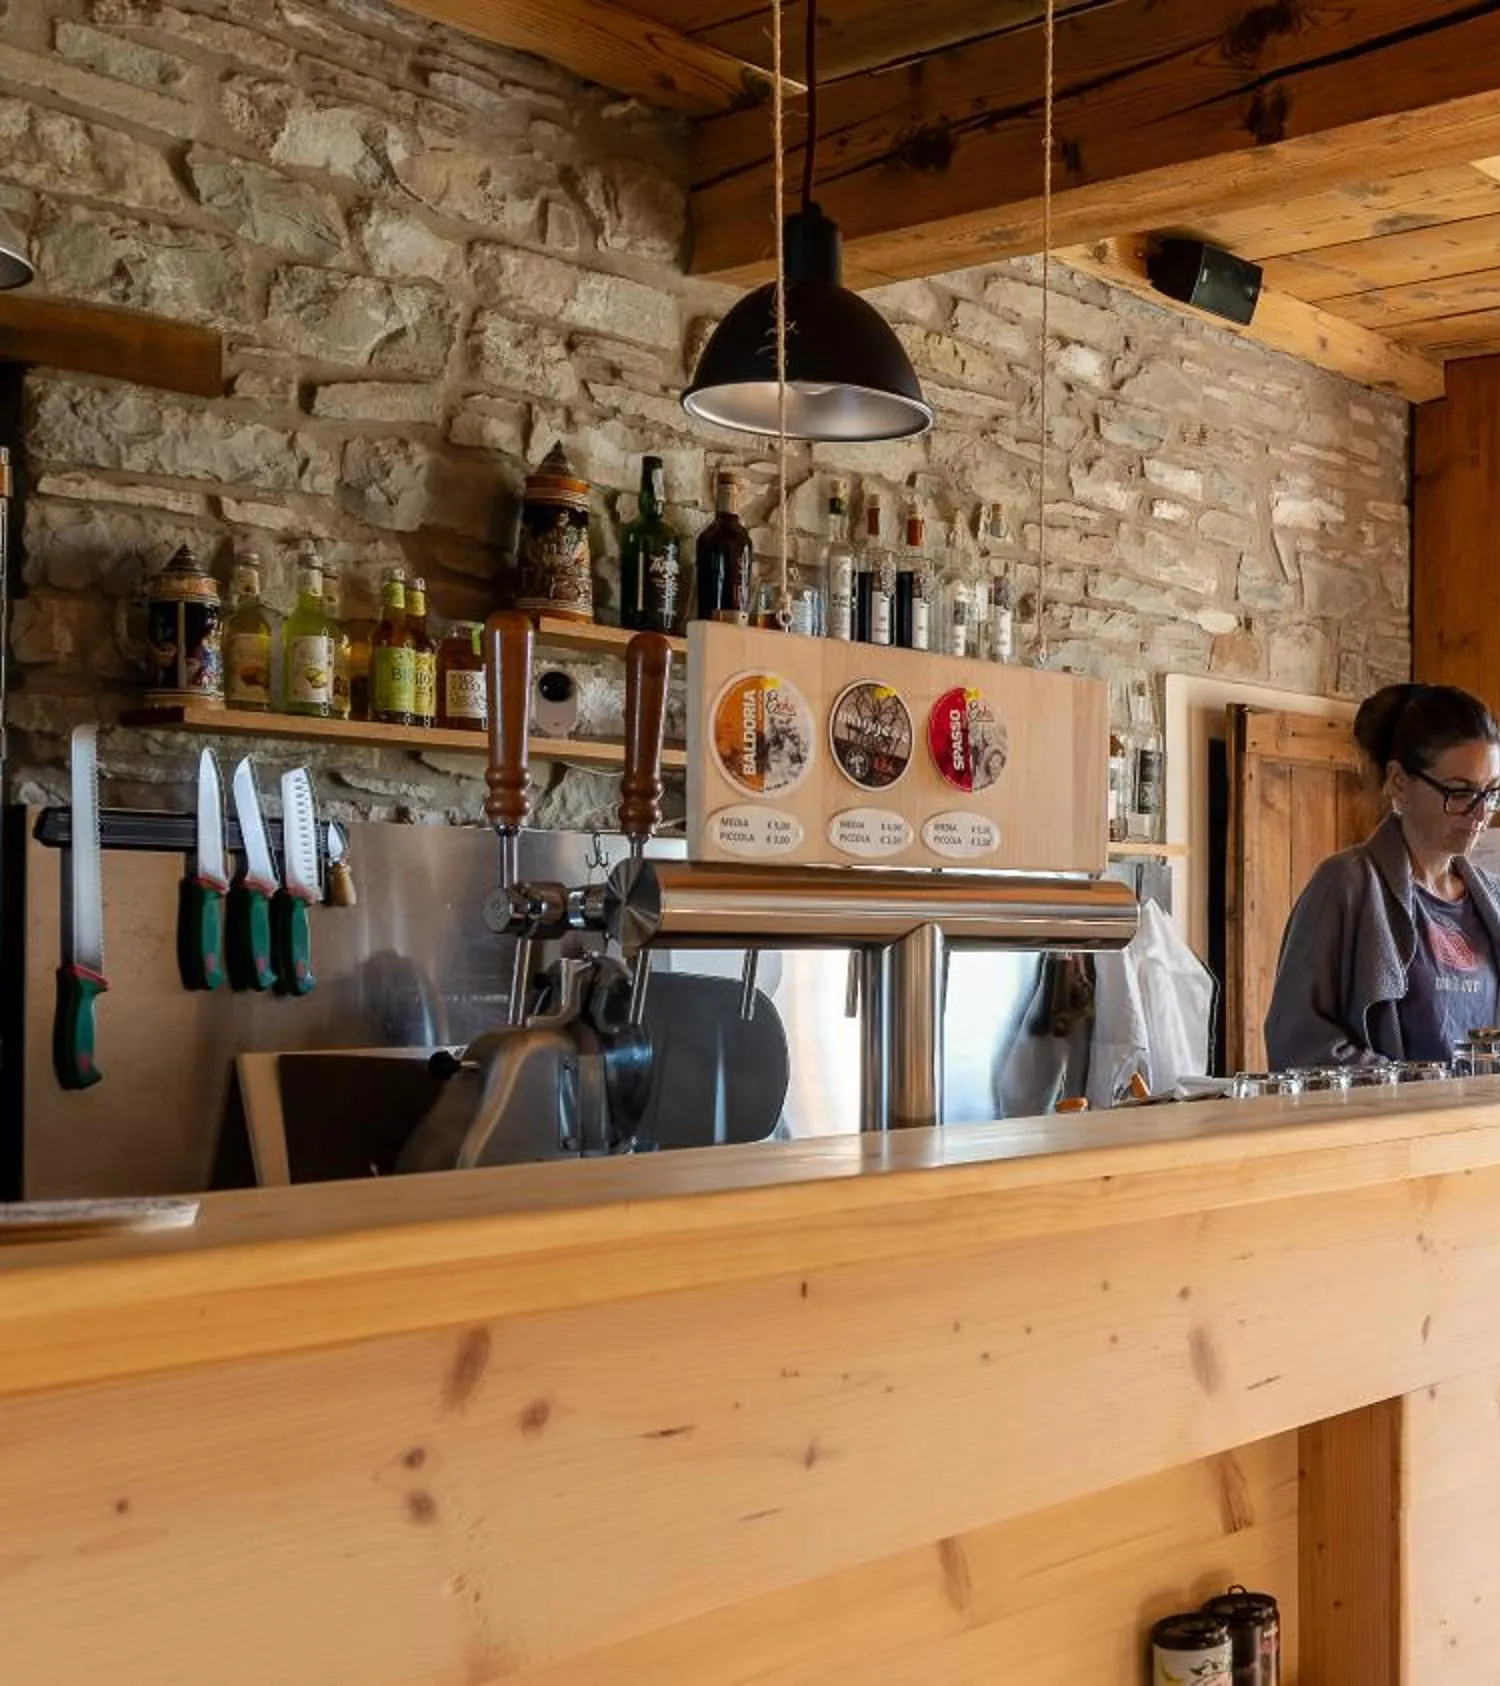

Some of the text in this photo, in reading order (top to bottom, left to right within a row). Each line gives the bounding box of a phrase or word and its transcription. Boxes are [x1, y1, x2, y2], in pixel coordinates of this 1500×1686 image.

[743, 689, 757, 776] BALDORIA
[950, 708, 965, 772] SPASSO
[719, 831, 755, 842] PICCOLA
